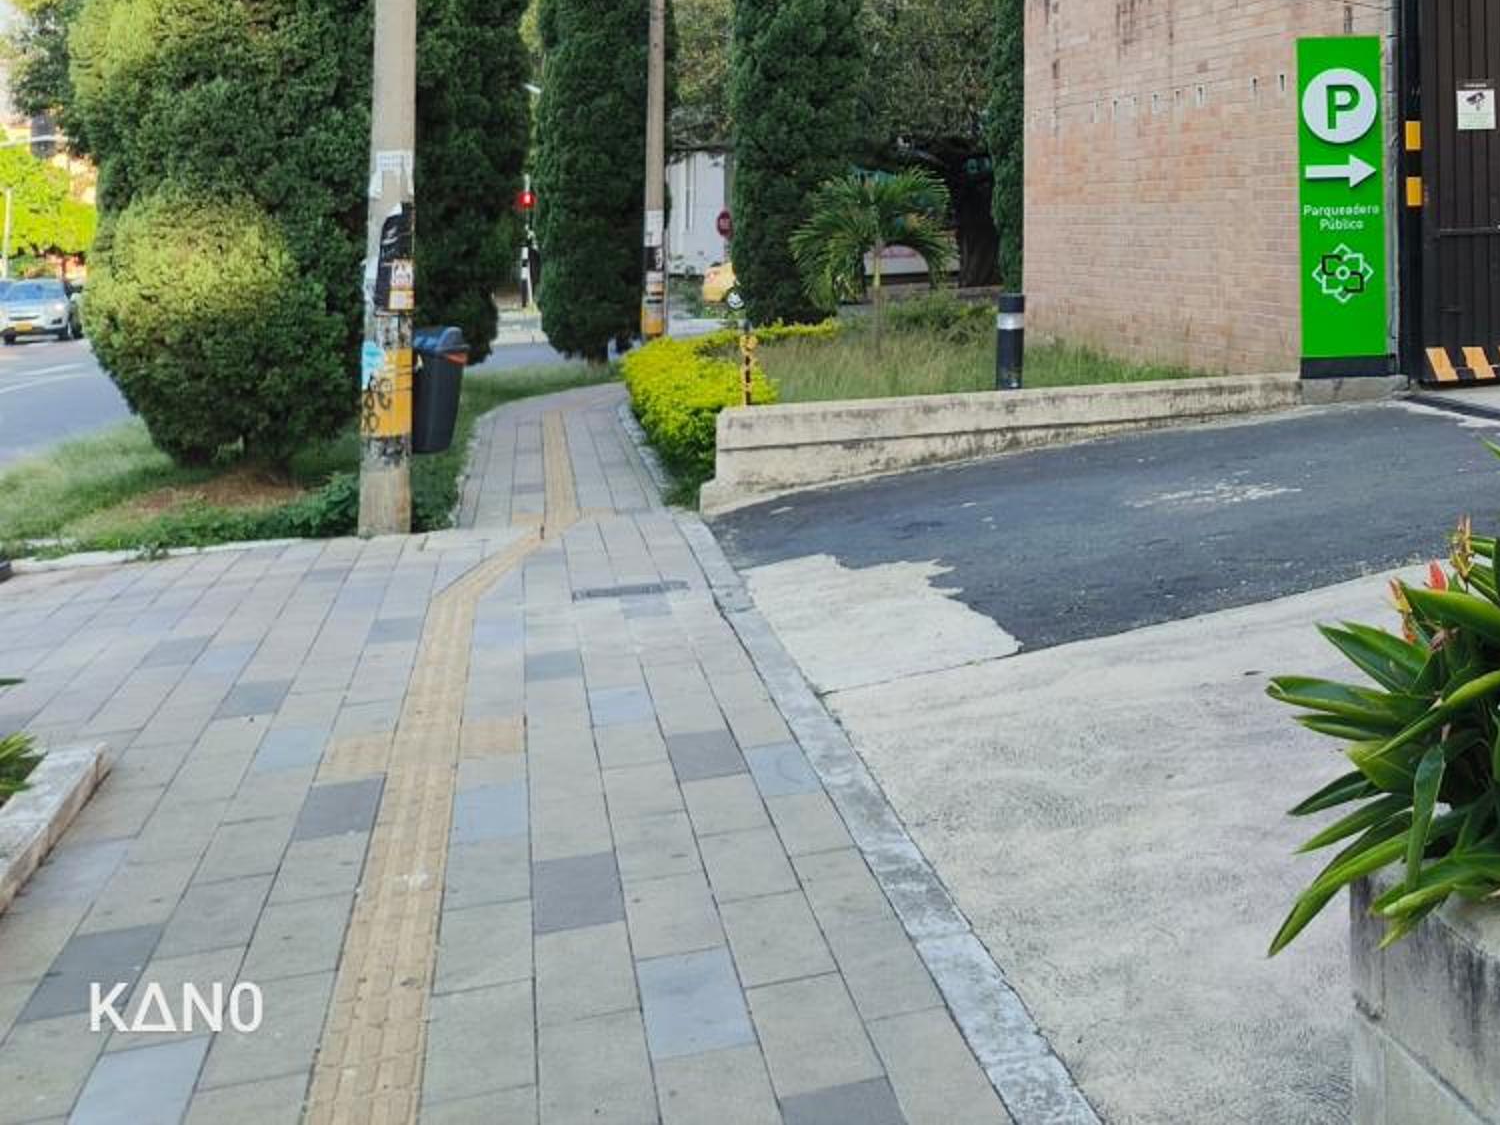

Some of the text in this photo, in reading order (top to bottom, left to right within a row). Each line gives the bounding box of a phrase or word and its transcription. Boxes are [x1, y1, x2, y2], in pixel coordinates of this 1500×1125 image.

[1325, 84, 1361, 130] P
[1303, 204, 1380, 217] Parqueadero
[1319, 218, 1365, 231] Público
